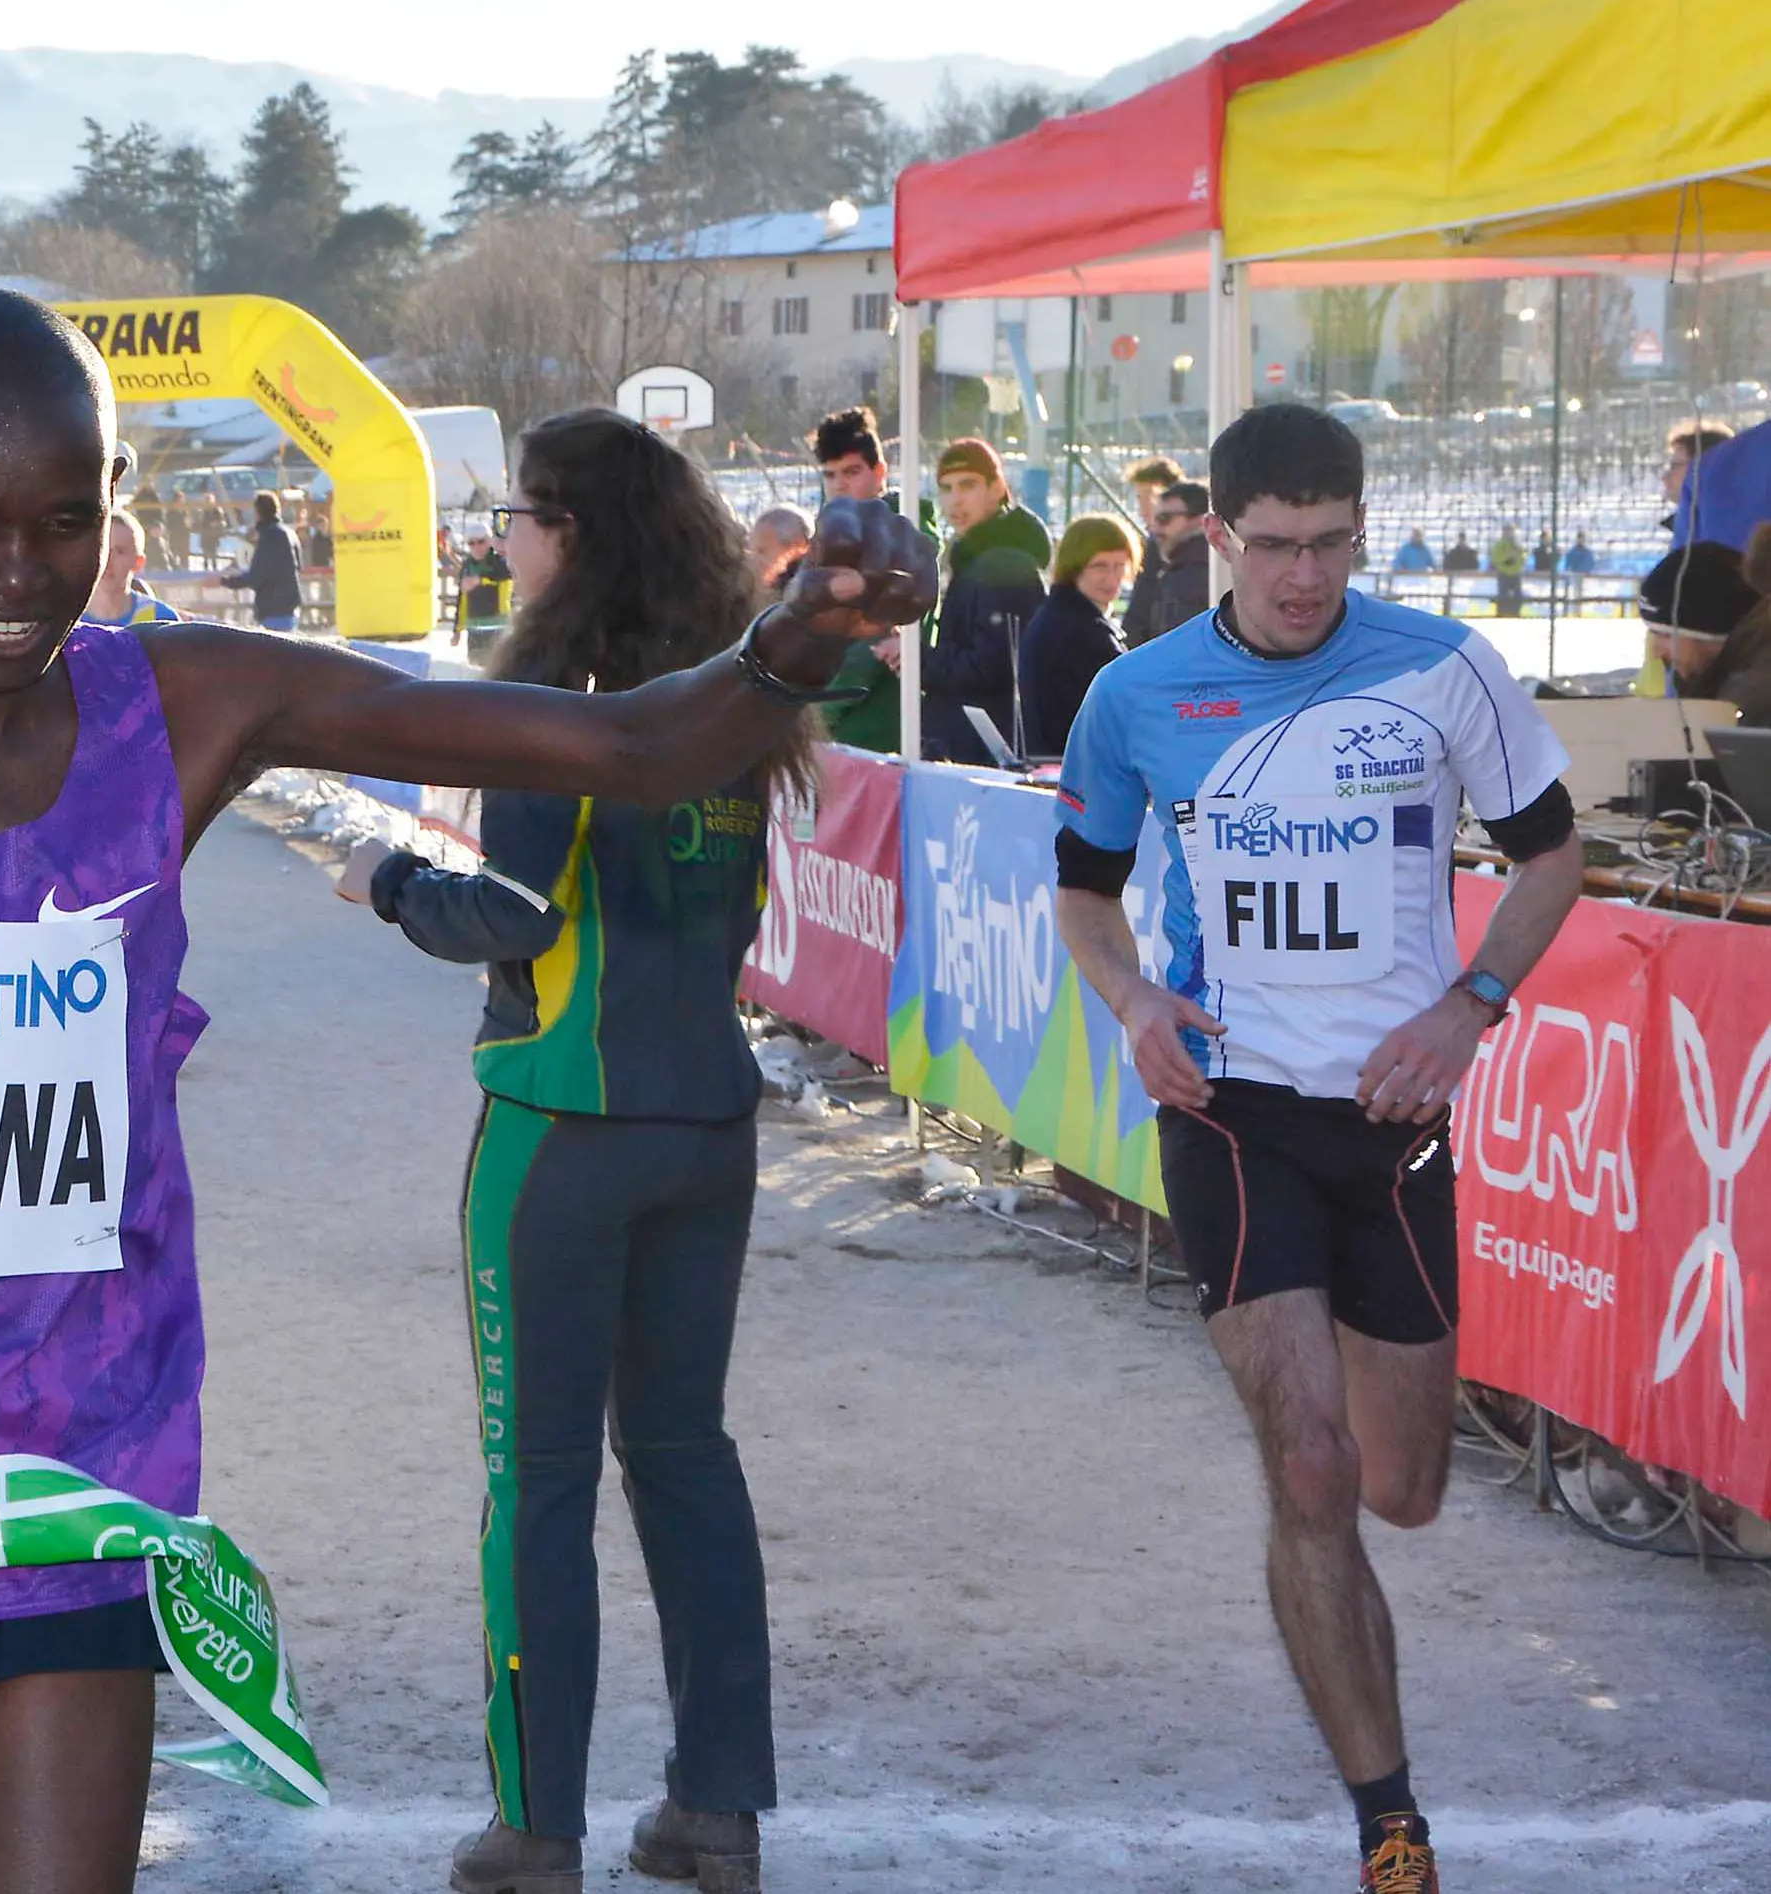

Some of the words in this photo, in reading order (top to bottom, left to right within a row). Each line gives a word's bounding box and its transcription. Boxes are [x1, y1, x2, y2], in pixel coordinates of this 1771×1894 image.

[117, 359, 211, 390] mondo
[251, 368, 334, 458] TRENTINGRANA
[1171, 699, 1242, 720] PLOSE
[1335, 763, 1355, 781] SG
[1207, 811, 1379, 857] TRENTINO
[925, 838, 1054, 1047] TRENTINO
[1224, 880, 1359, 951] FILL
[1474, 1220, 1618, 1310] Equipage
[478, 1266, 506, 1475] QUERCIA
